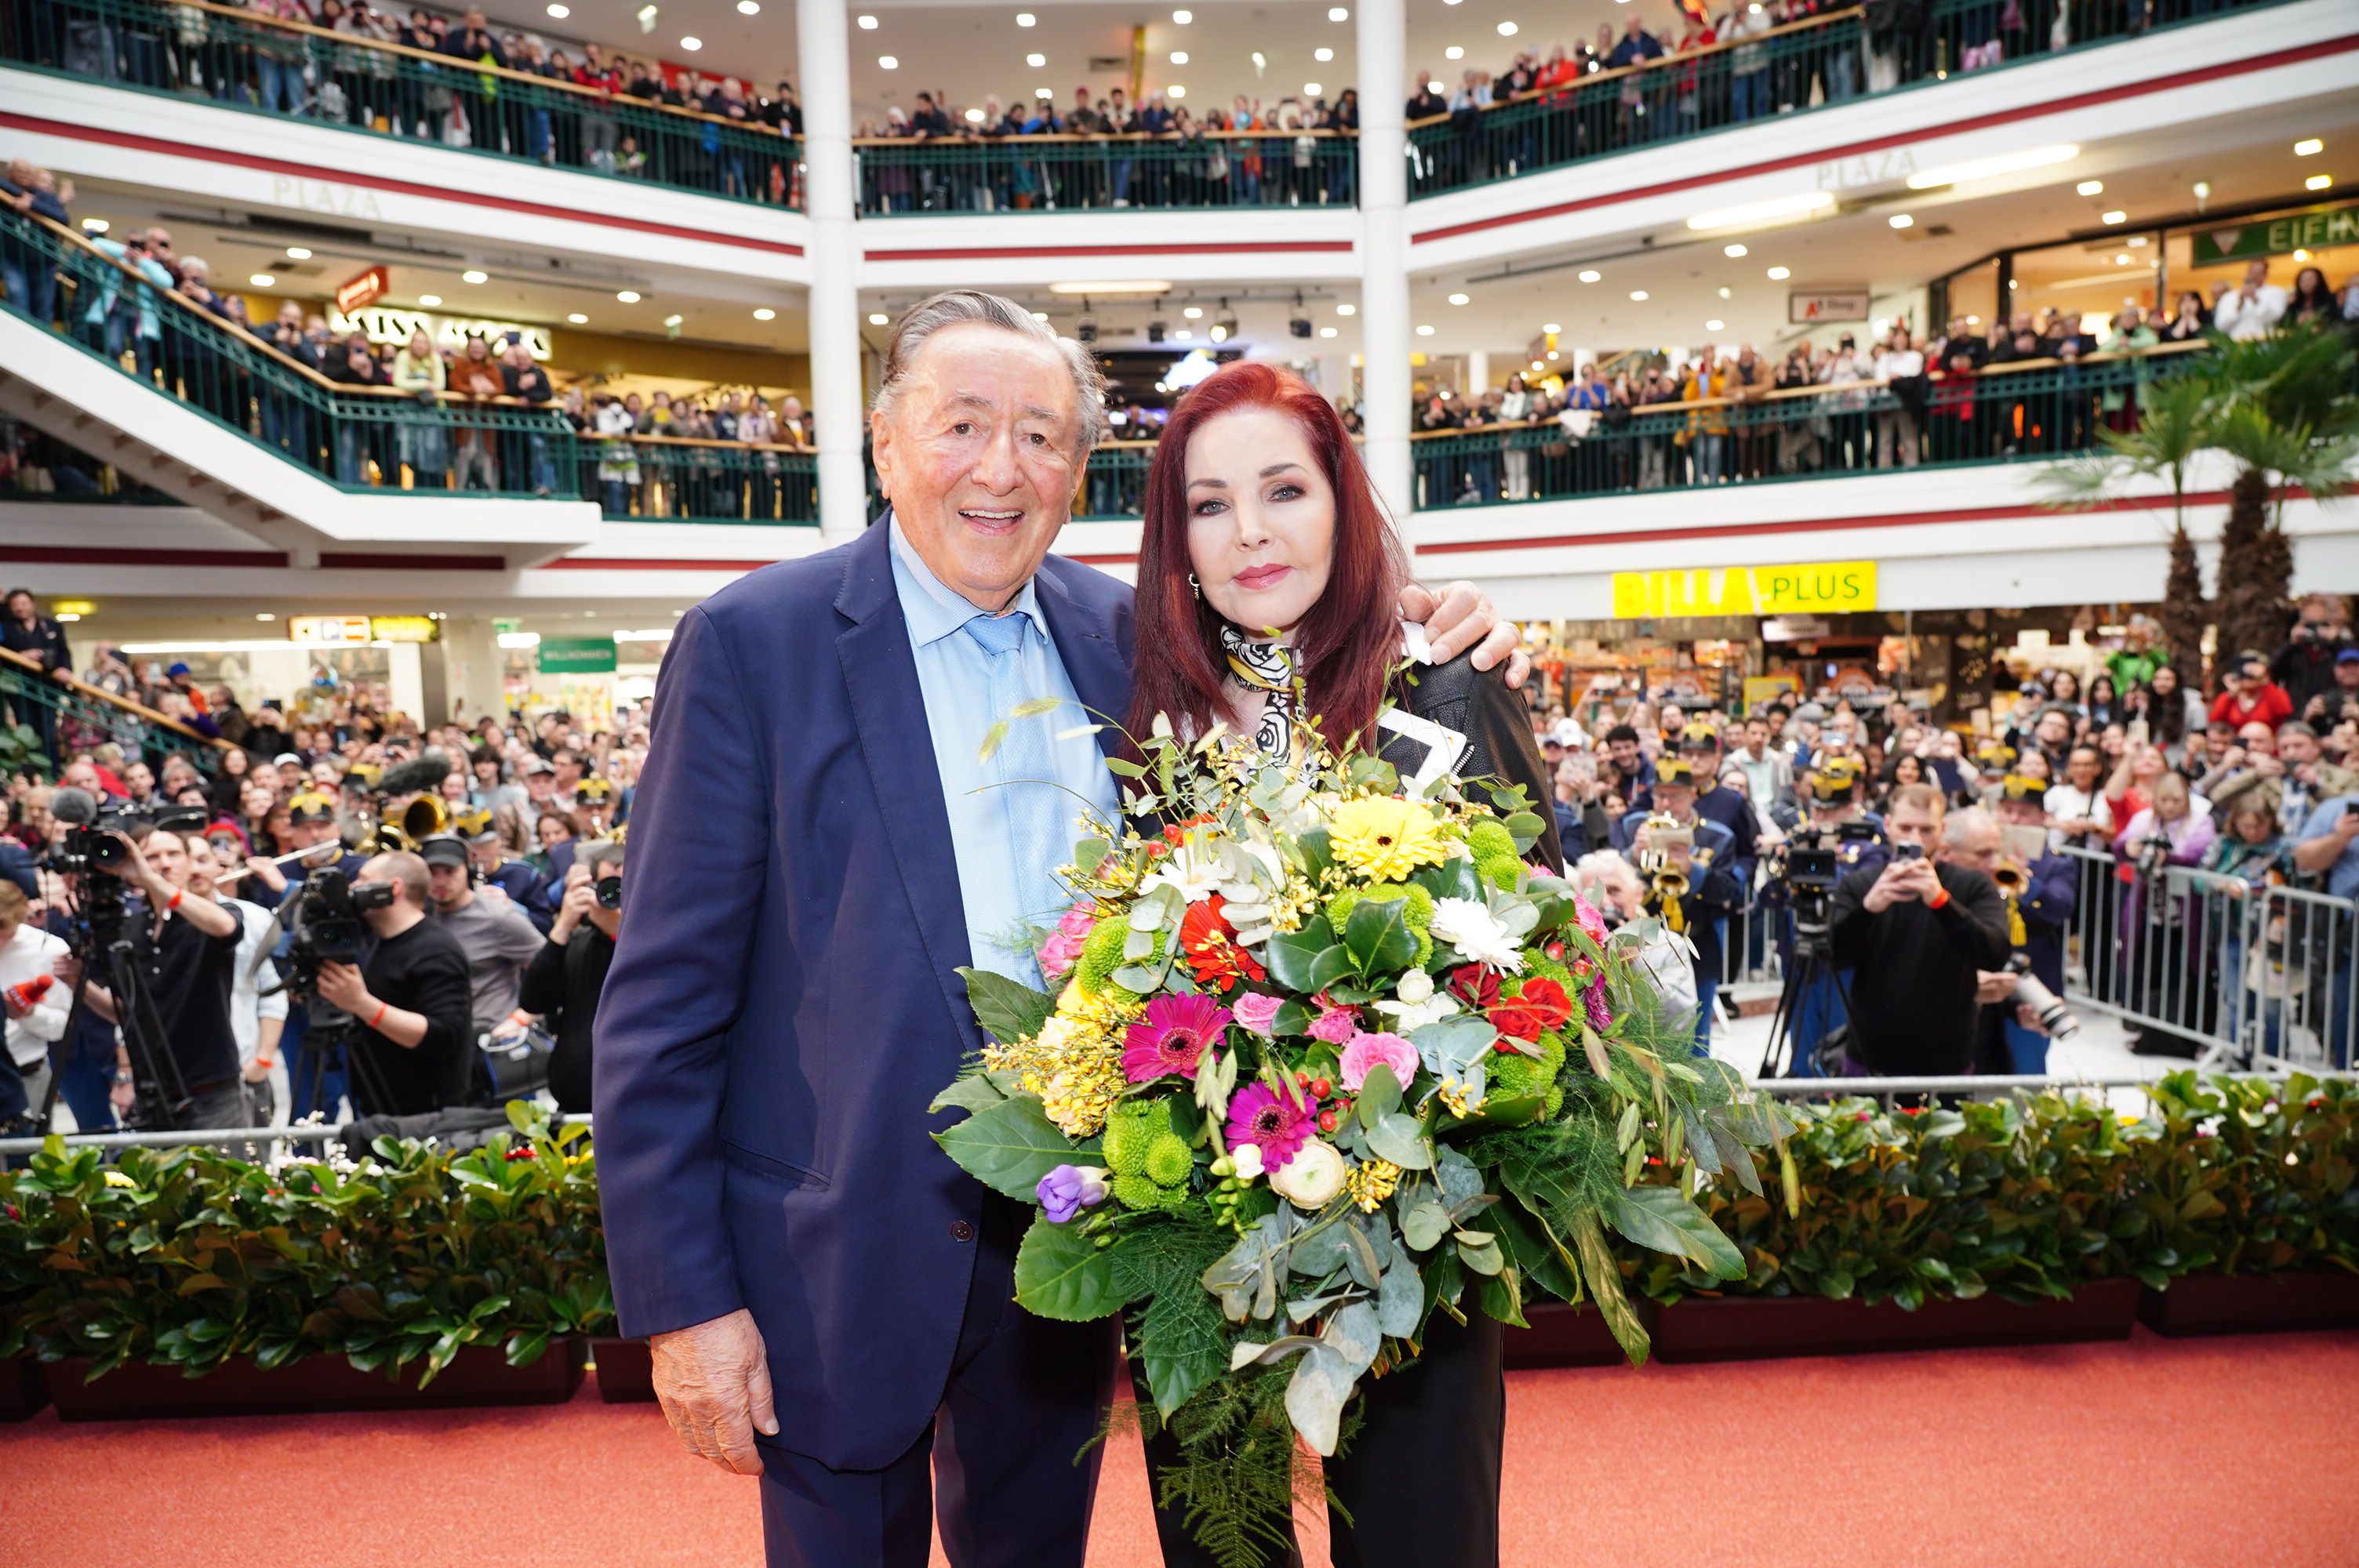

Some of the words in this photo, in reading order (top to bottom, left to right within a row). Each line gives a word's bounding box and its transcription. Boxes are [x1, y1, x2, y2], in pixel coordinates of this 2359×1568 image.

[1817, 149, 1918, 190] PLAZA
[273, 174, 382, 220] PLAZA
[1612, 566, 1754, 619] BILLA
[1773, 574, 1861, 601] PLUS
